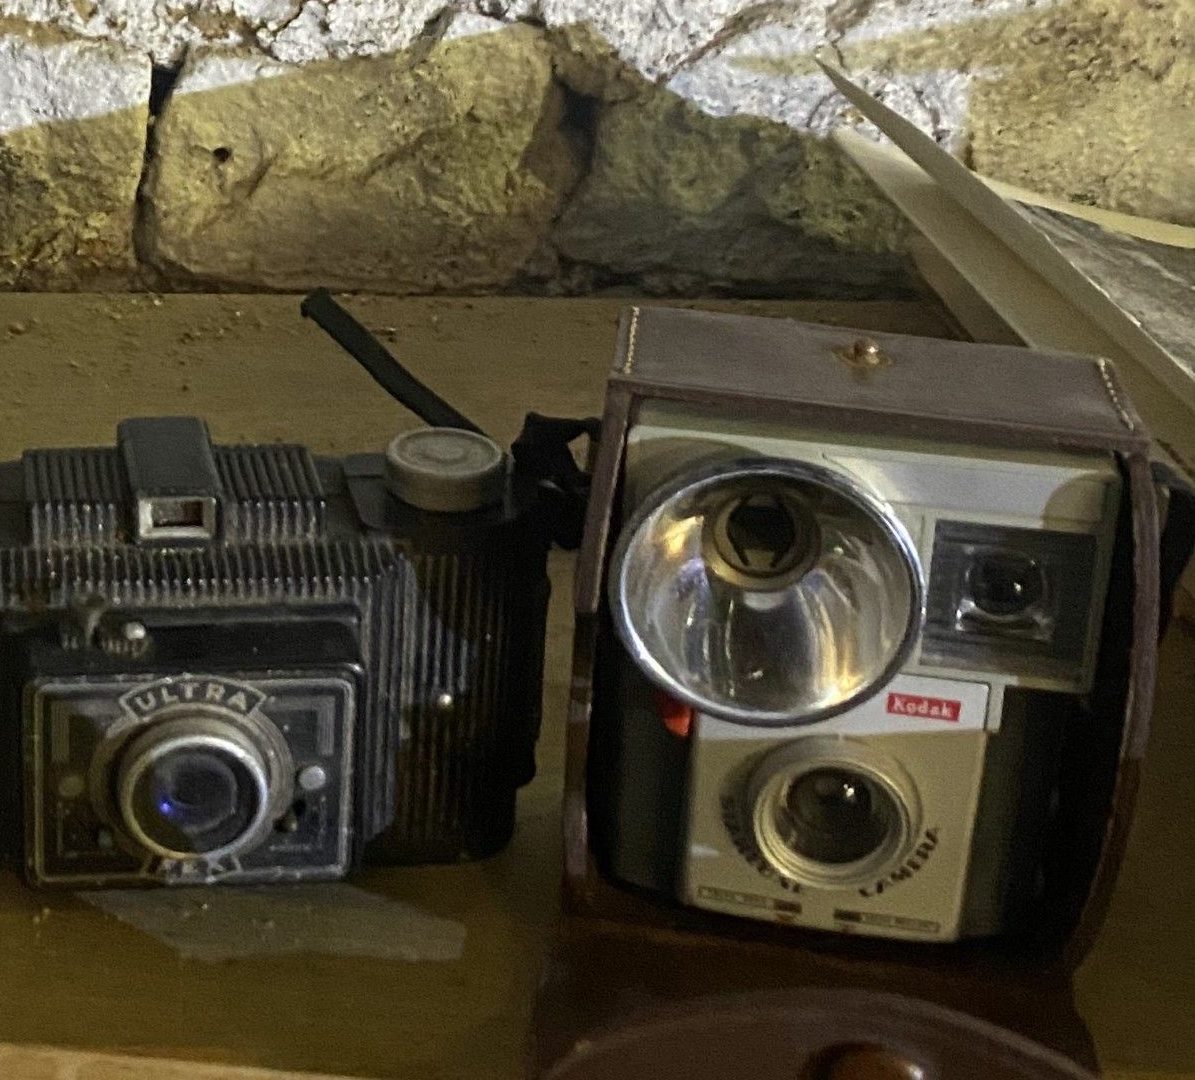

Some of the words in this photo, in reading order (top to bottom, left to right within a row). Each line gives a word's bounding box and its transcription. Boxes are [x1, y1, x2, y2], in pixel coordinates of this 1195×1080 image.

[135, 681, 249, 711] ULTRA
[891, 696, 955, 719] Kodak
[857, 825, 941, 899] CAMERA
